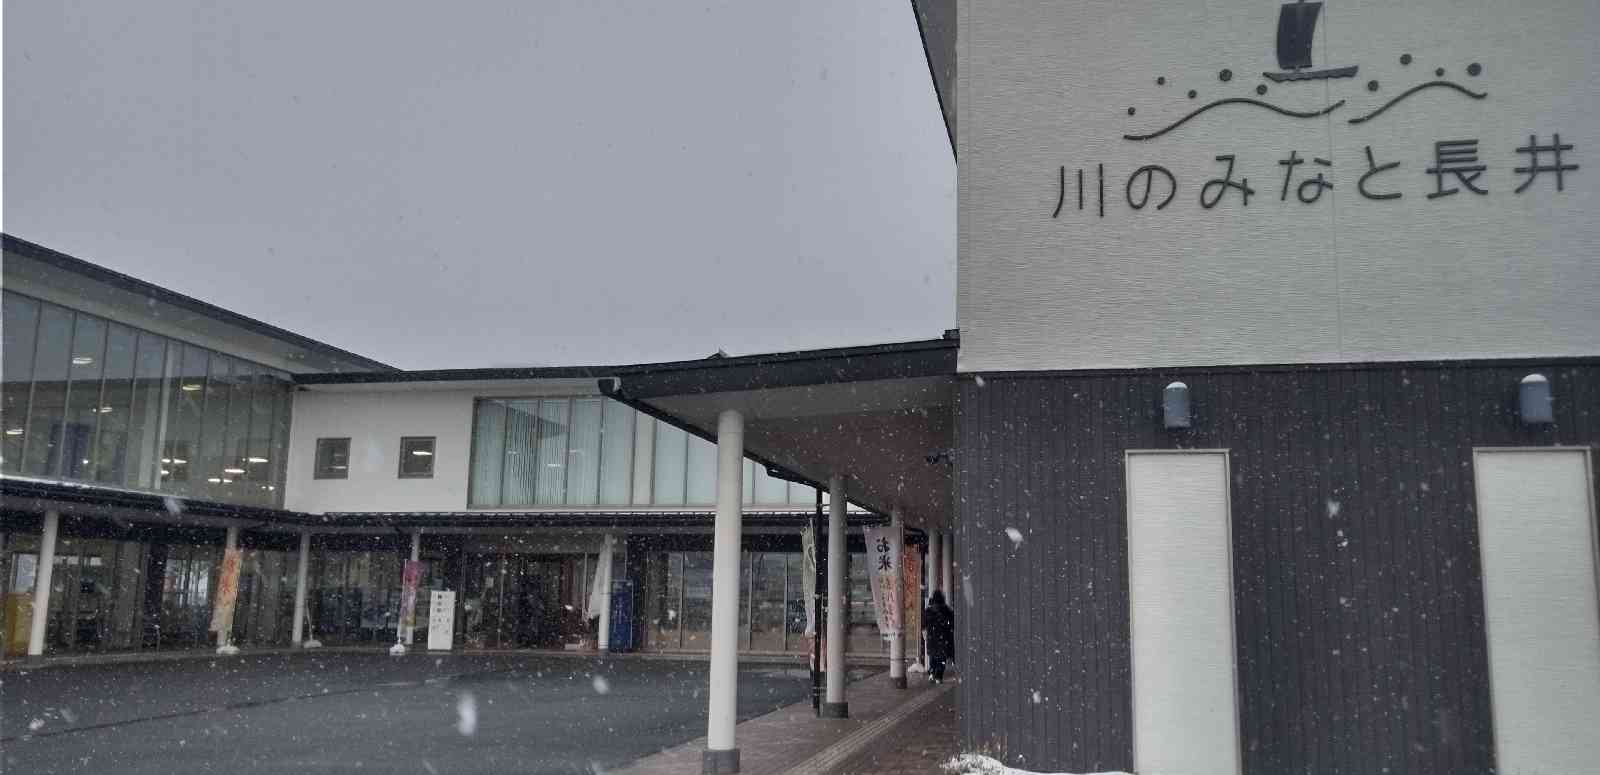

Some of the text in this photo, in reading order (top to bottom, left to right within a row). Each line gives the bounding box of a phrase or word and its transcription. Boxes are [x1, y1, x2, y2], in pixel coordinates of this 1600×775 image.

[1053, 133, 1580, 218] 川のみなと長井
